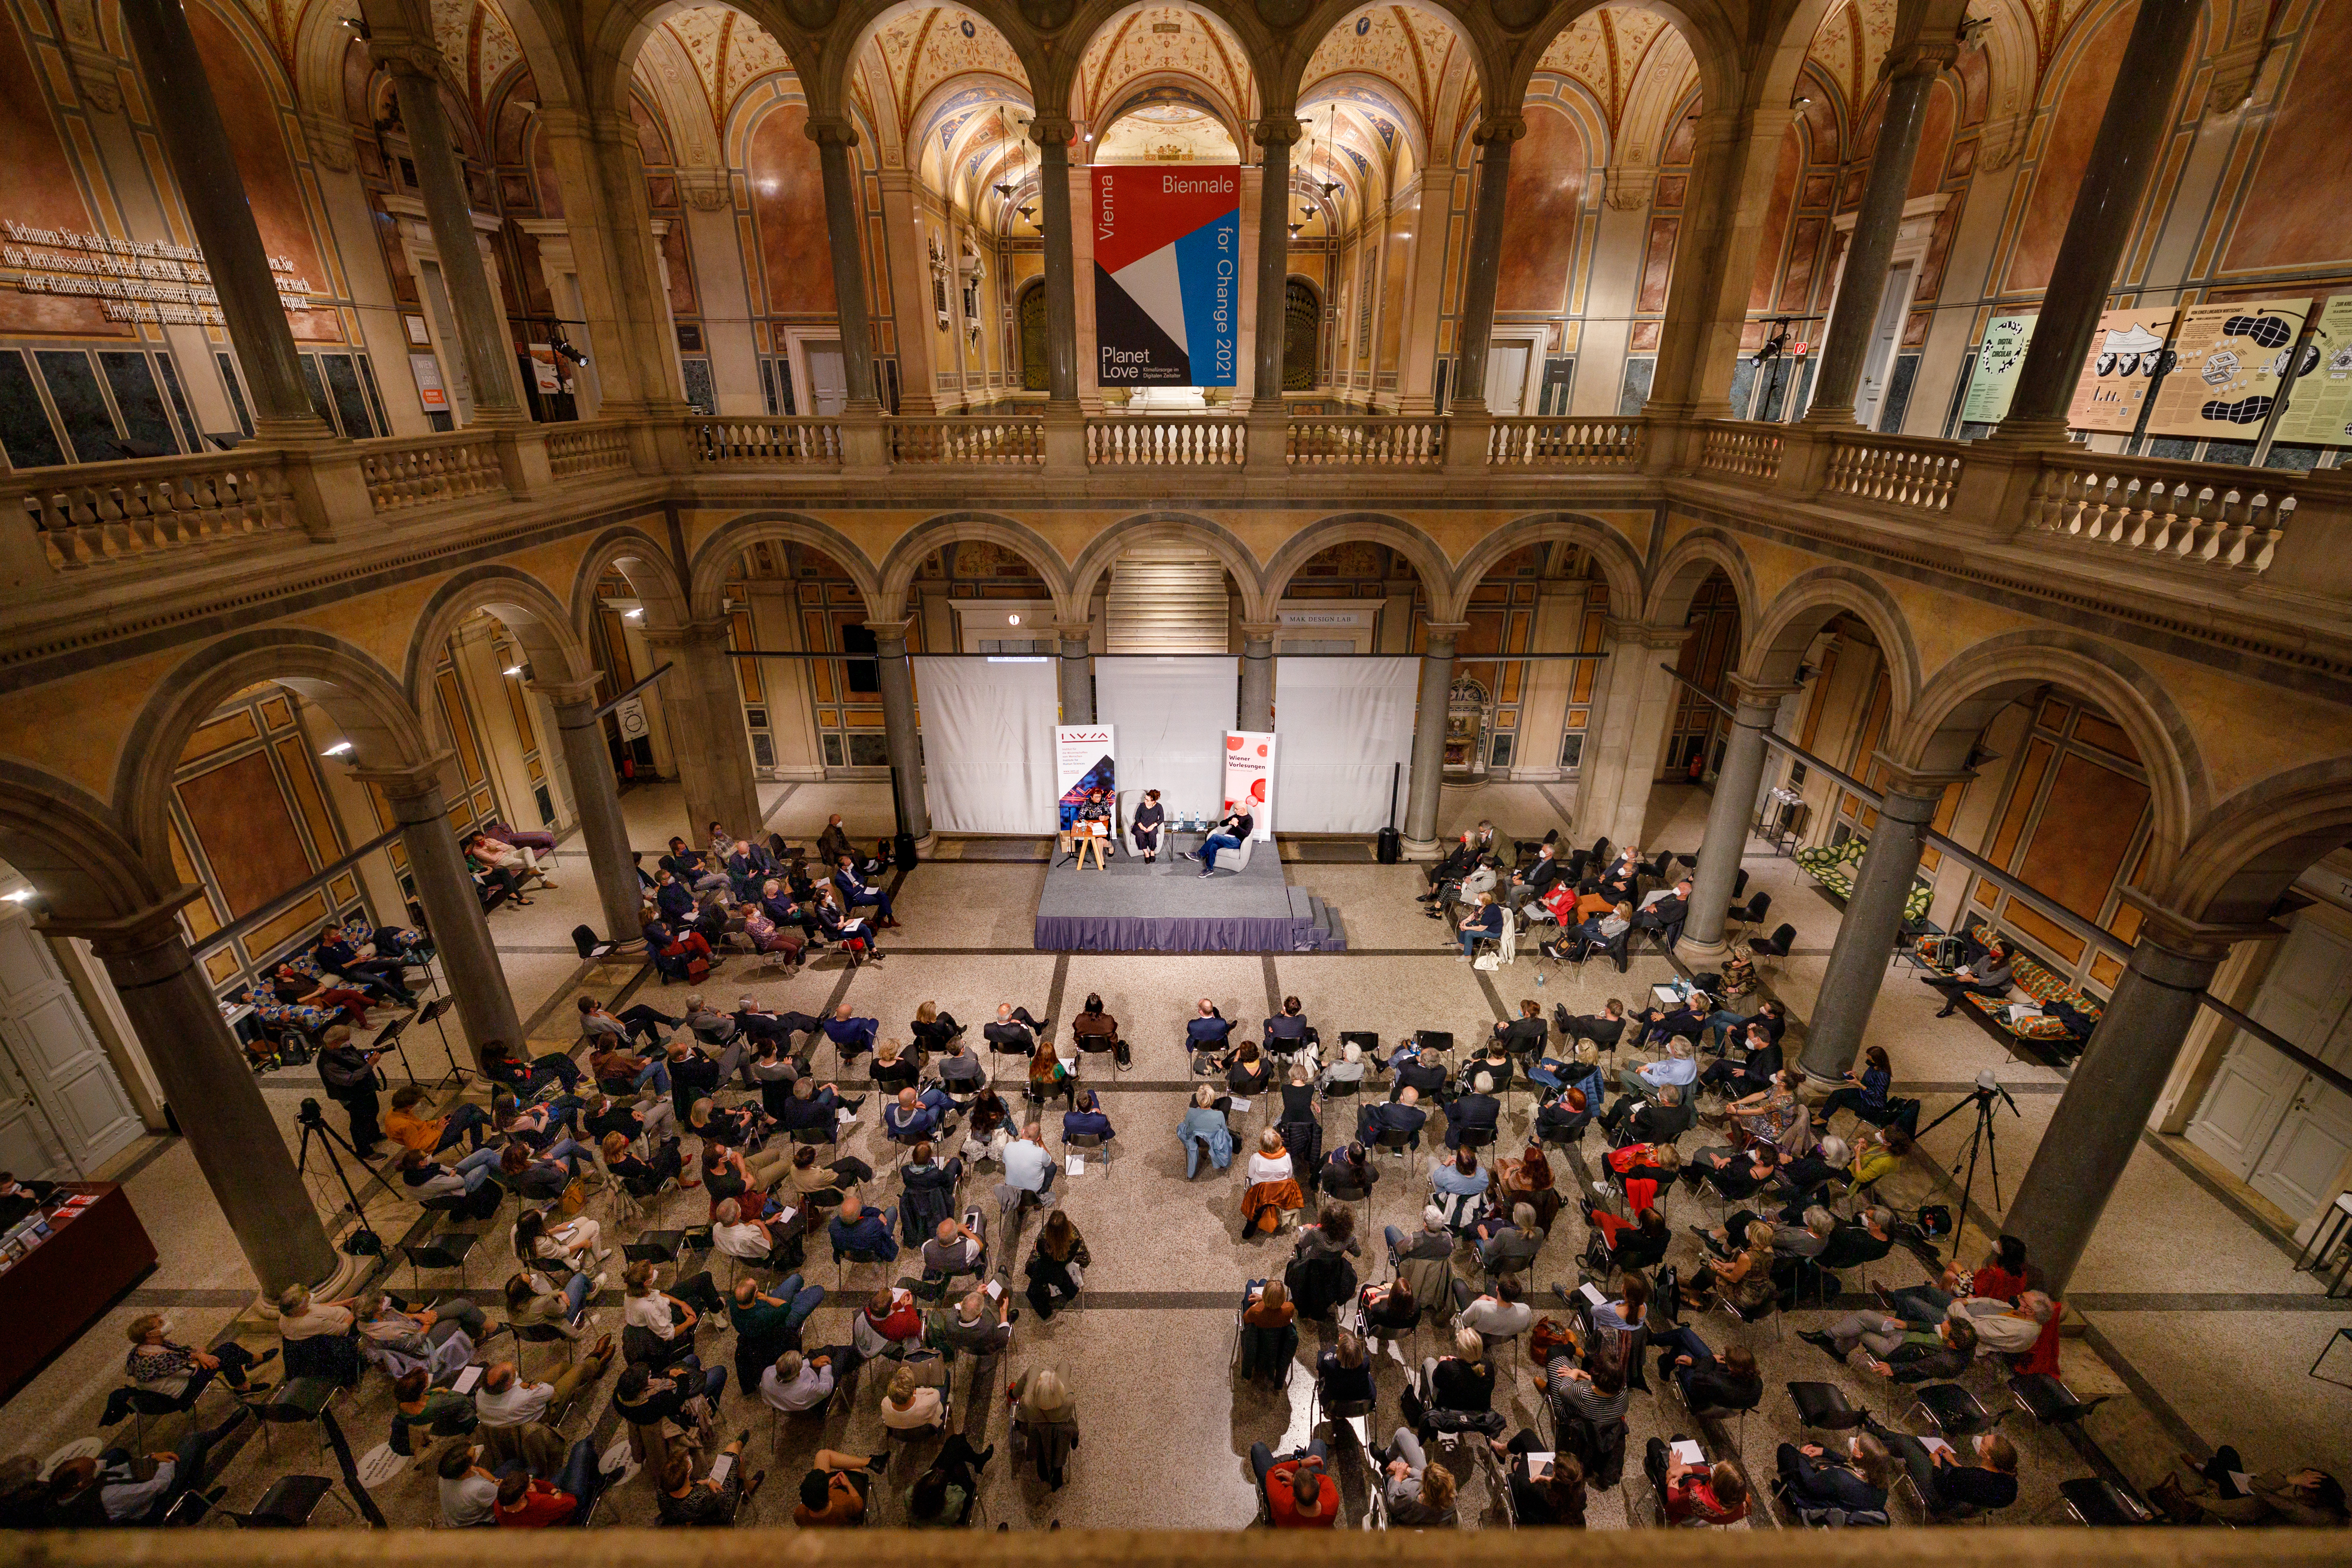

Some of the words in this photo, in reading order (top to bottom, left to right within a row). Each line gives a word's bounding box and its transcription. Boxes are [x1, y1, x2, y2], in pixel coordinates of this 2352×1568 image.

[1163, 175, 1233, 193] Biennale
[1099, 175, 1114, 241] Vienna
[5, 220, 63, 245] Nehmen
[60, 227, 82, 247] Sie
[83, 232, 109, 251] sich
[109, 235, 129, 253] ein
[129, 240, 155, 257] paar
[157, 239, 200, 260] Minuten
[279, 255, 294, 271] Sie
[1218, 226, 1233, 253] for
[3, 246, 26, 266] die
[141, 260, 159, 277] des
[183, 262, 200, 281] Sie
[289, 277, 312, 292] nach
[24, 272, 45, 291] der
[46, 274, 125, 296] italienischen
[122, 278, 187, 301] Renaissance
[280, 293, 312, 312] riginal.
[1214, 258, 1232, 333] Change
[103, 300, 160, 323] Trotzdem
[159, 304, 195, 325] finden
[194, 308, 209, 322] wir
[1102, 346, 1149, 363] Planet
[1216, 338, 1232, 379] 2021
[422, 376, 437, 385] 1900
[1103, 364, 1138, 378] Love
[1229, 762, 1265, 770] Vorlesungen
